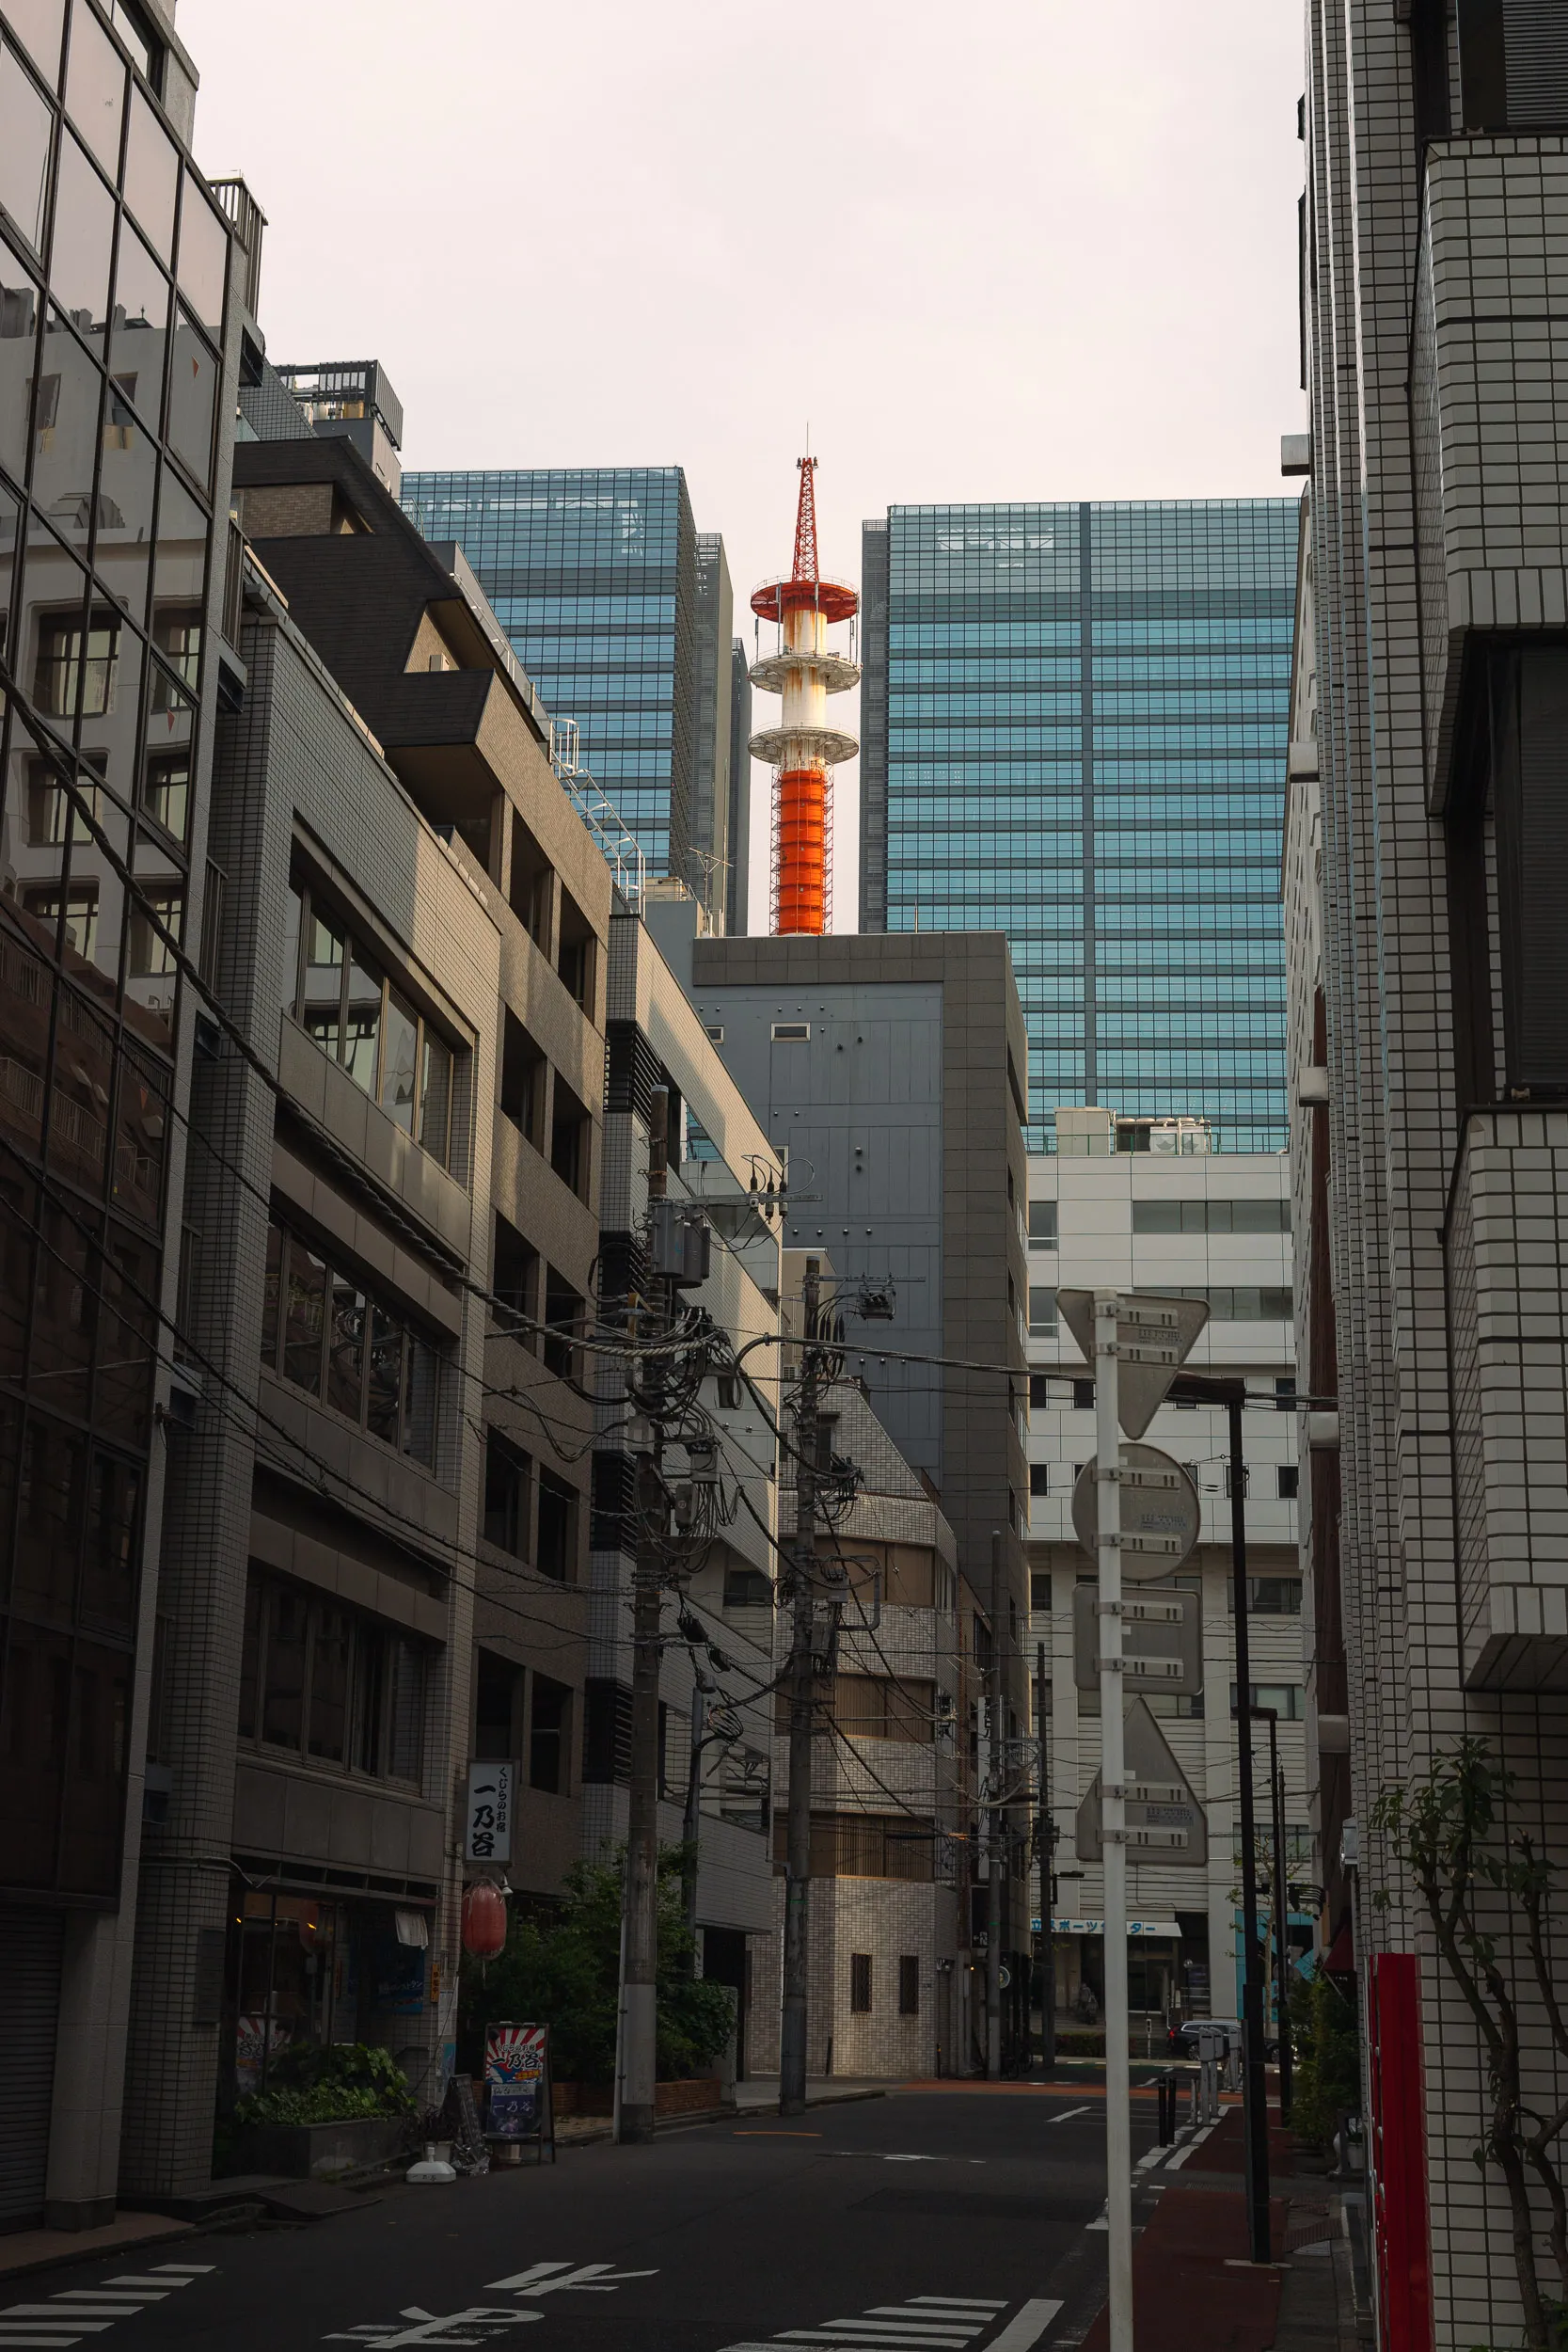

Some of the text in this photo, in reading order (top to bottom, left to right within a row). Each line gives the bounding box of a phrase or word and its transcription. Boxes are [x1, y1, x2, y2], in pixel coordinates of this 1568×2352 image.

[496, 1766, 508, 1833] くじらのお宿
[471, 1784, 496, 1857] 一乃谷
[1031, 1918, 1156, 1934] 立ポーツター
[492, 2053, 539, 2069] 一乃谷
[493, 2100, 533, 2113] 一乃谷
